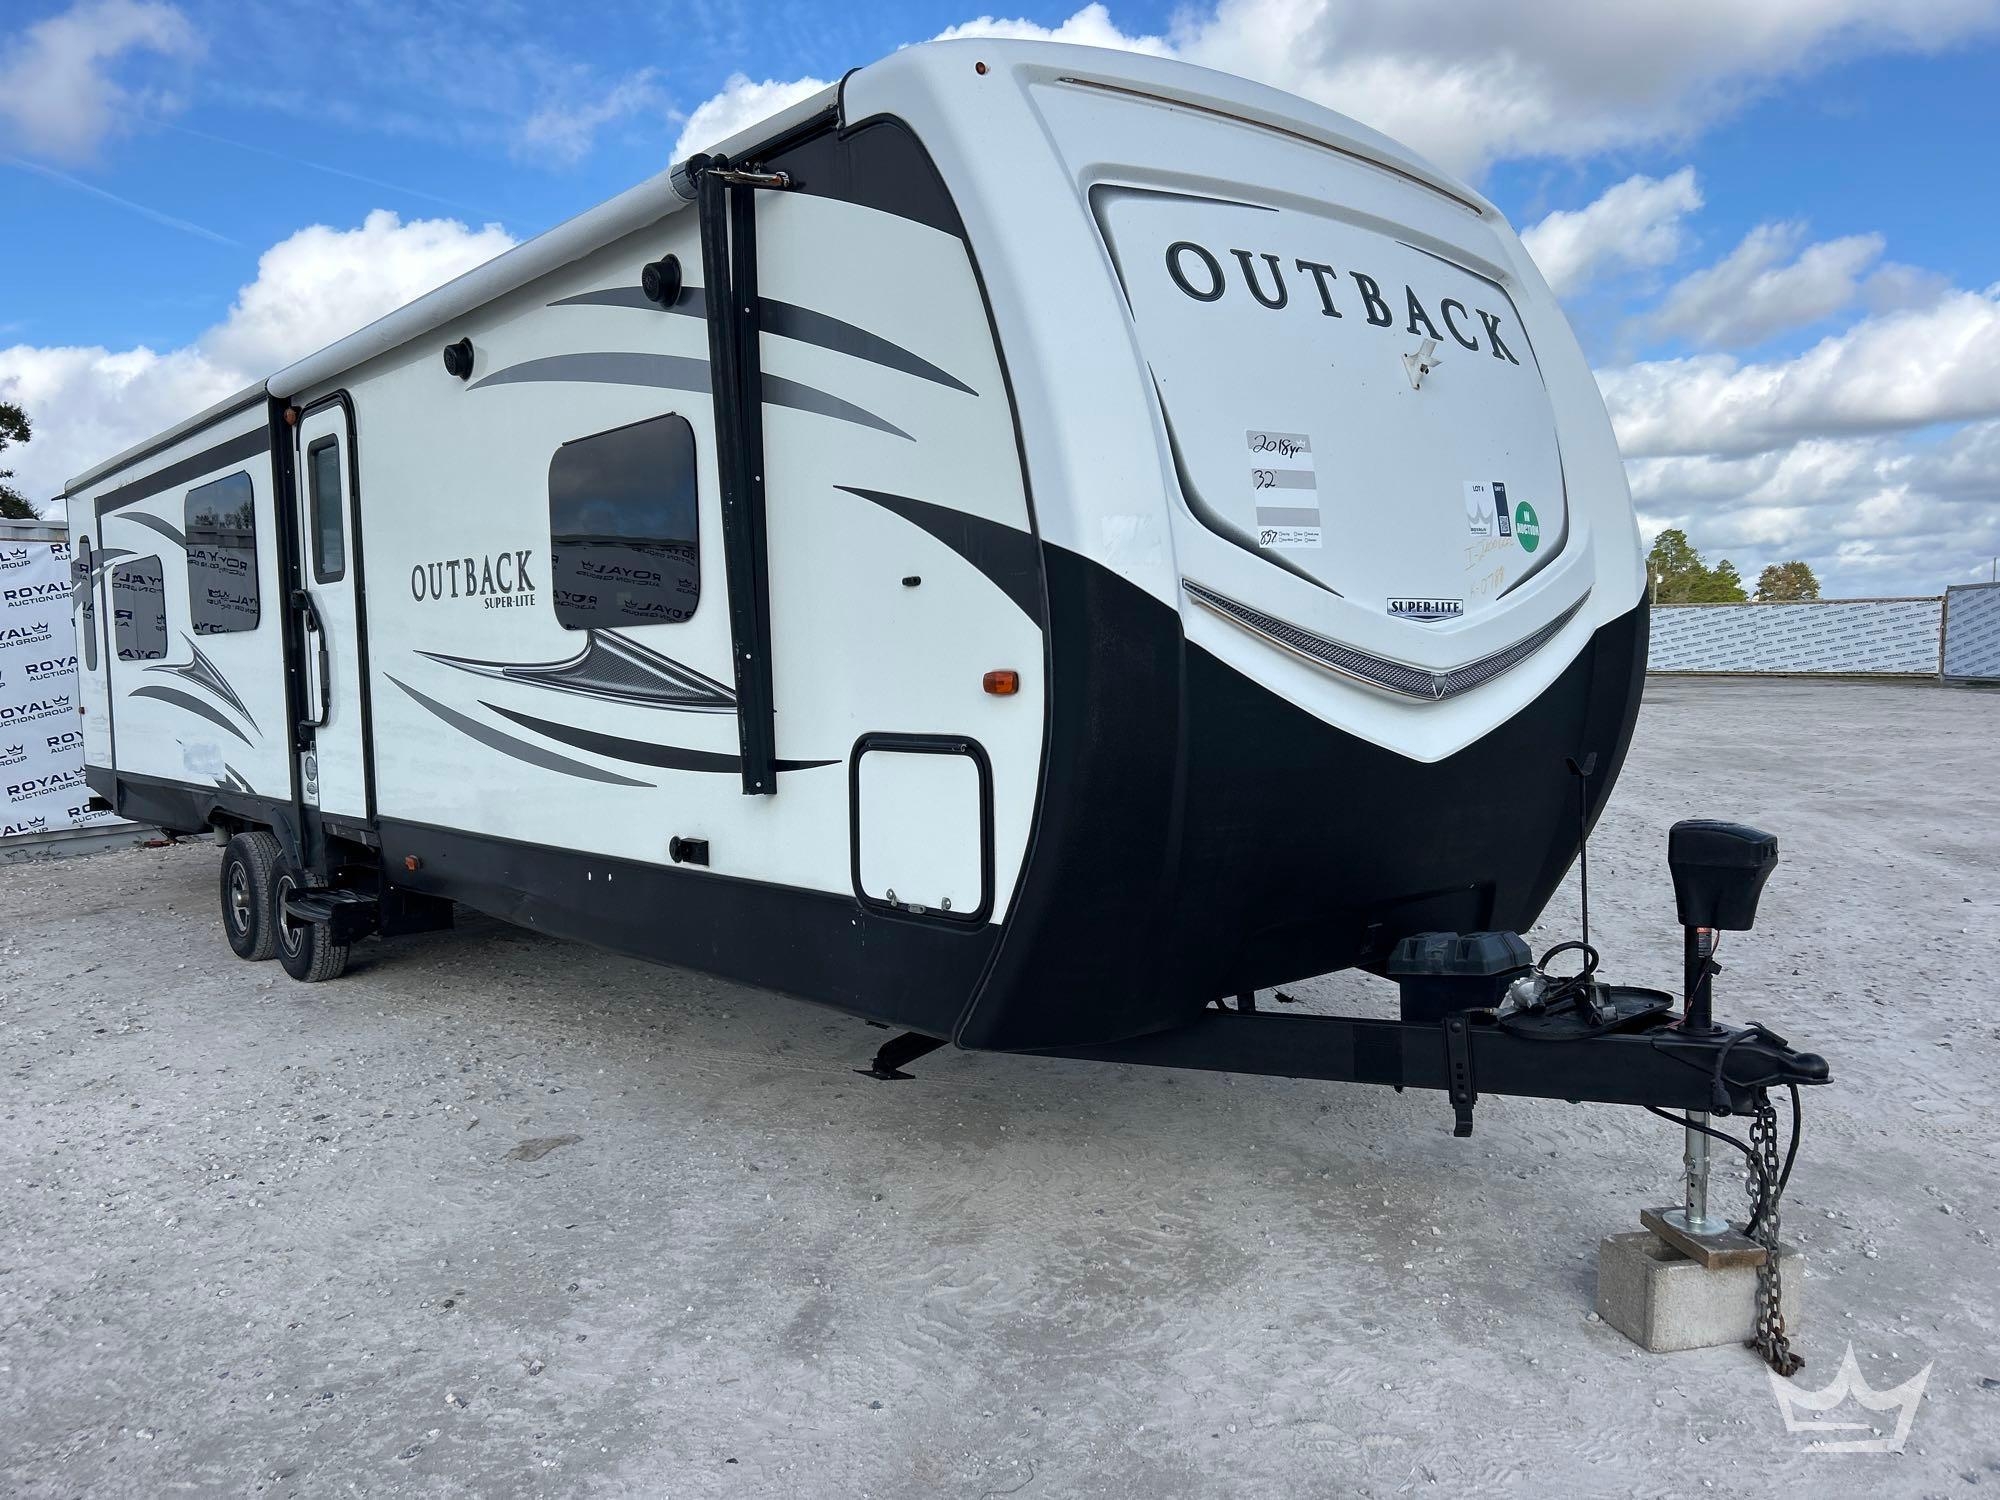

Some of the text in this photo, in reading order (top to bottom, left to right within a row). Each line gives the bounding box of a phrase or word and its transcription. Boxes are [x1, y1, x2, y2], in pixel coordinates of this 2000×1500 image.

[1165, 241, 1520, 365] OUTBACK
[411, 550, 536, 602] OUTBACK
[4, 581, 71, 600] ROYAL
[8, 595, 53, 608] AUCTION
[484, 594, 535, 609] SUPER-LITE
[1391, 600, 1459, 613] SUPER-LITE
[16, 633, 52, 646] GROUP
[25, 656, 77, 674] ROYA
[29, 668, 74, 681] AUCTION
[0, 700, 53, 719] OYAL
[38, 705, 73, 719] GROUP
[7, 772, 74, 796] ROYAL
[11, 778, 86, 803] AUCTION GROU
